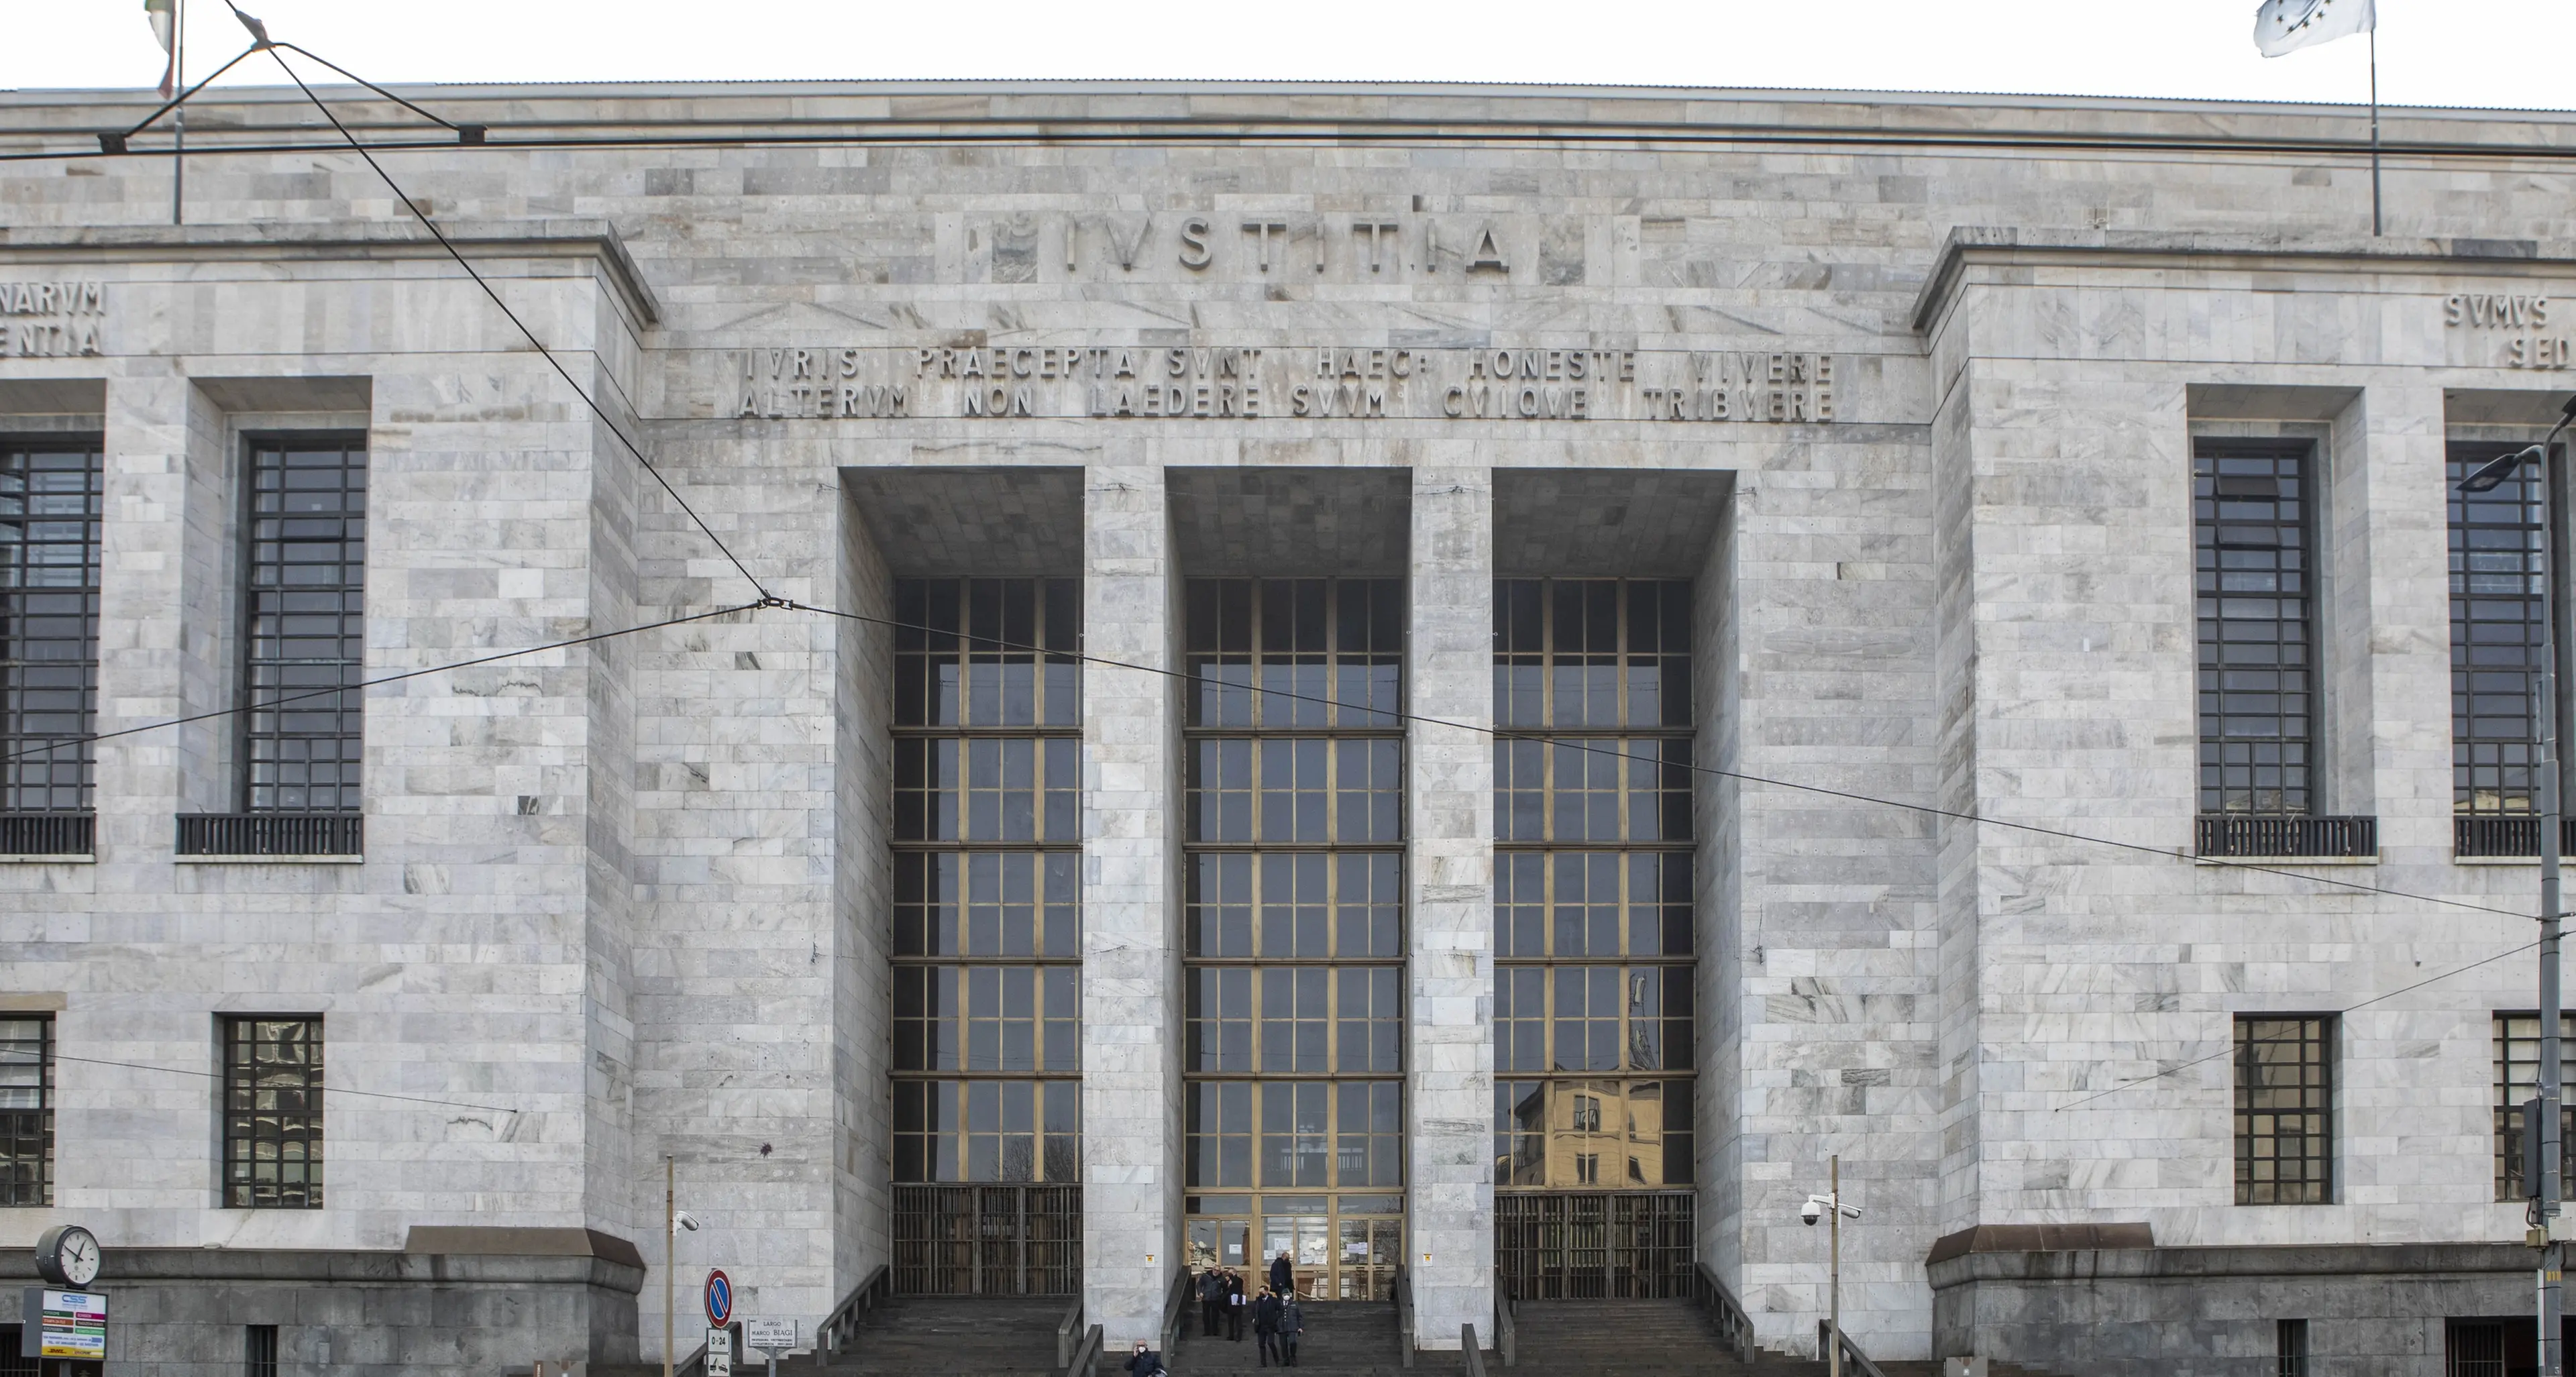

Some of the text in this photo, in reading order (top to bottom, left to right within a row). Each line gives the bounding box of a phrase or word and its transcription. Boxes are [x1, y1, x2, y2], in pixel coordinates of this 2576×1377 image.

[1066, 216, 1510, 272] IVSTITIA
[2445, 294, 2548, 329] SVMVS
[746, 346, 1832, 384] IVRIS PRAECEPTA SVNT HAEC: HONESTE VIVERE
[2508, 335, 2570, 370] SED
[738, 384, 1833, 423] ALTERVM NON LAEDERE SVVM CVIQVE TRIBVERE
[62, 1294, 88, 1303] CSS
